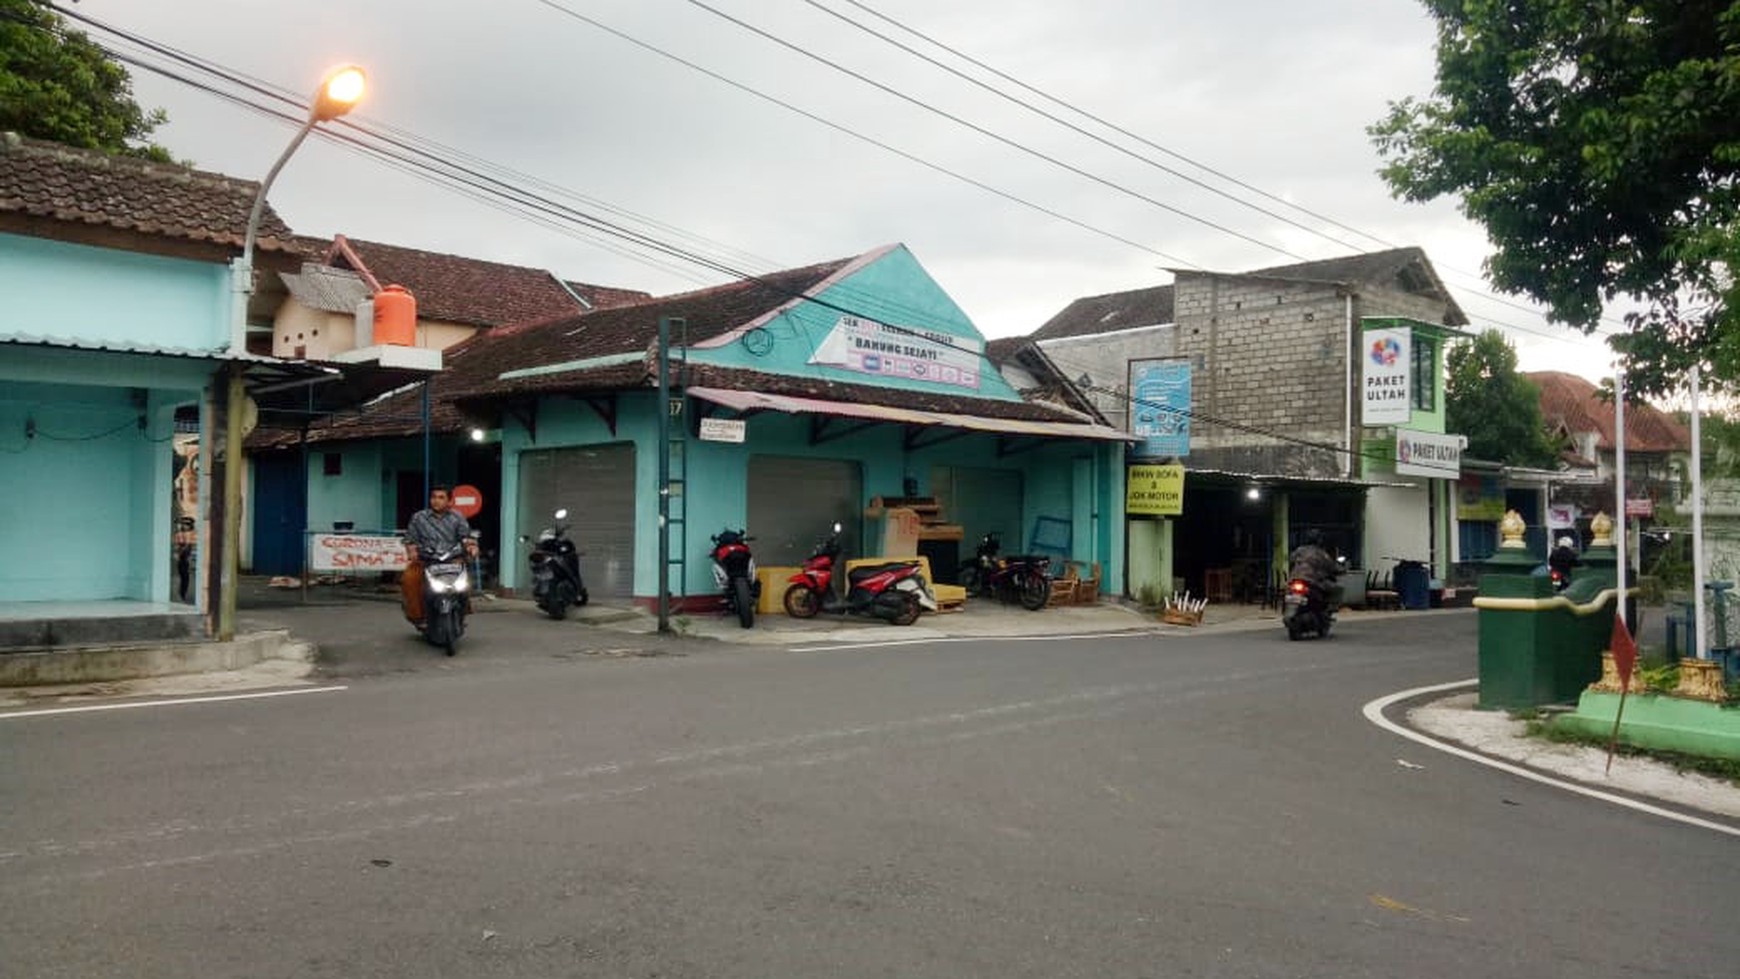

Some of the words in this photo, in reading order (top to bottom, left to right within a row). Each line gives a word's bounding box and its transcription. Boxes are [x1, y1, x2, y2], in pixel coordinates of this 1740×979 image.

[1367, 375, 1405, 387] PAKET
[1367, 389, 1406, 401] ULTAH
[1413, 442, 1435, 460] PAKET
[1436, 444, 1458, 461] ULTAH
[1148, 491, 1179, 501] MOTOR
